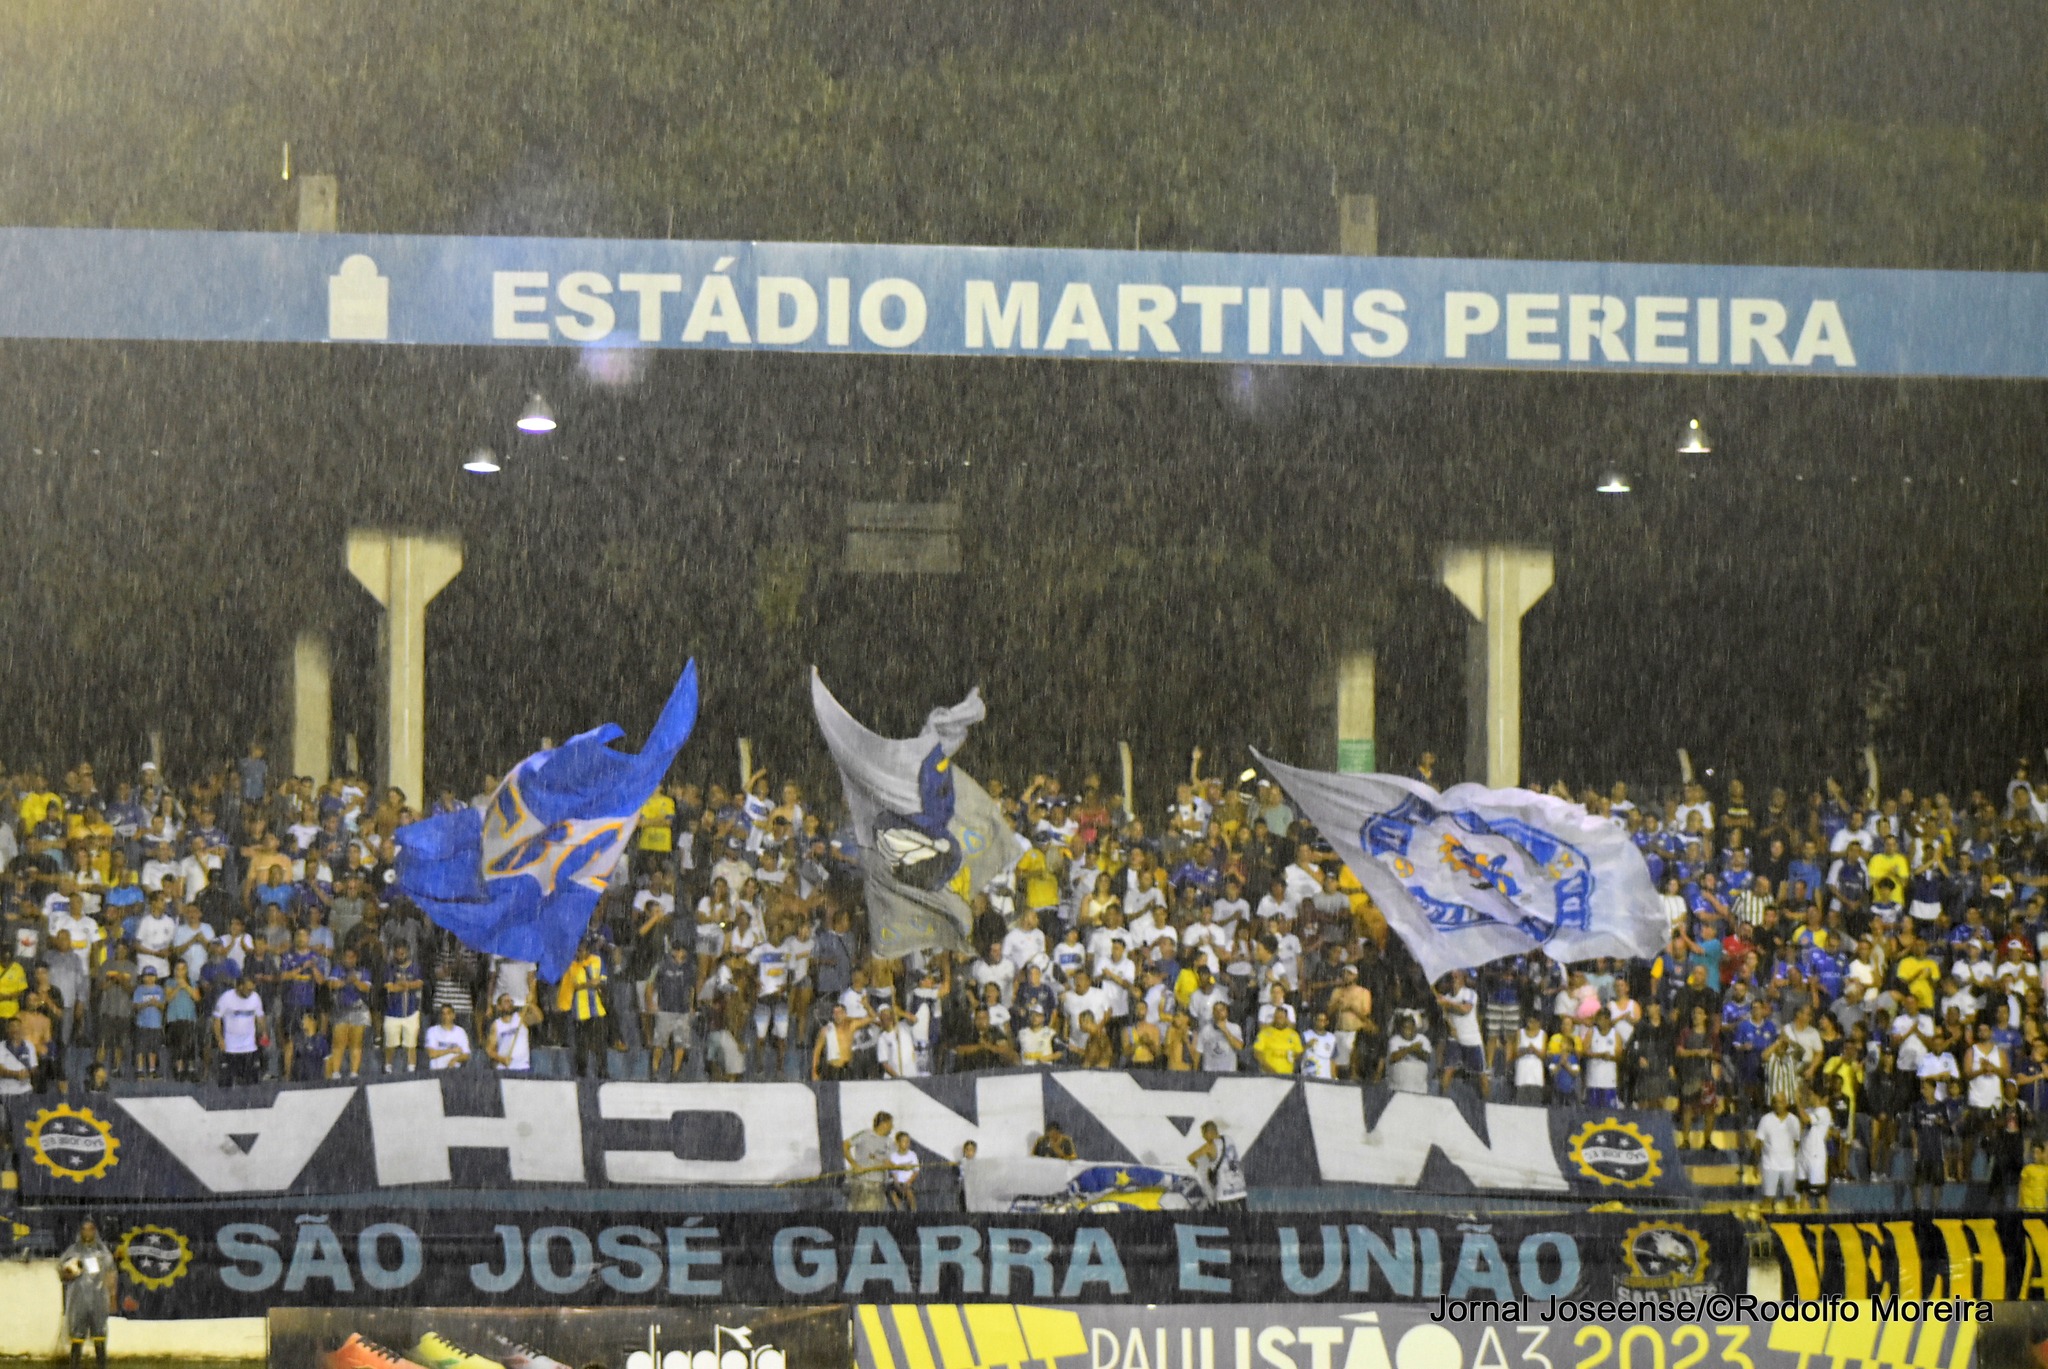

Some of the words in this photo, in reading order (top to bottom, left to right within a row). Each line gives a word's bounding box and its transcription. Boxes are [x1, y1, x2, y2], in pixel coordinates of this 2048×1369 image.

[493, 257, 927, 347] ESTÁDIO
[964, 280, 1409, 358] MARTINS
[1444, 291, 1857, 368] PEREIRA
[115, 1071, 1570, 1193] MANCHA
[217, 1214, 423, 1292] SÃO
[470, 1217, 723, 1295] JOSÉ
[773, 1225, 1130, 1296] GARRA
[1174, 1223, 1231, 1293] E
[1280, 1223, 1581, 1301] UNIÃO
[1472, 1326, 1553, 1369] A3
[1573, 1324, 1756, 1369] 2023
